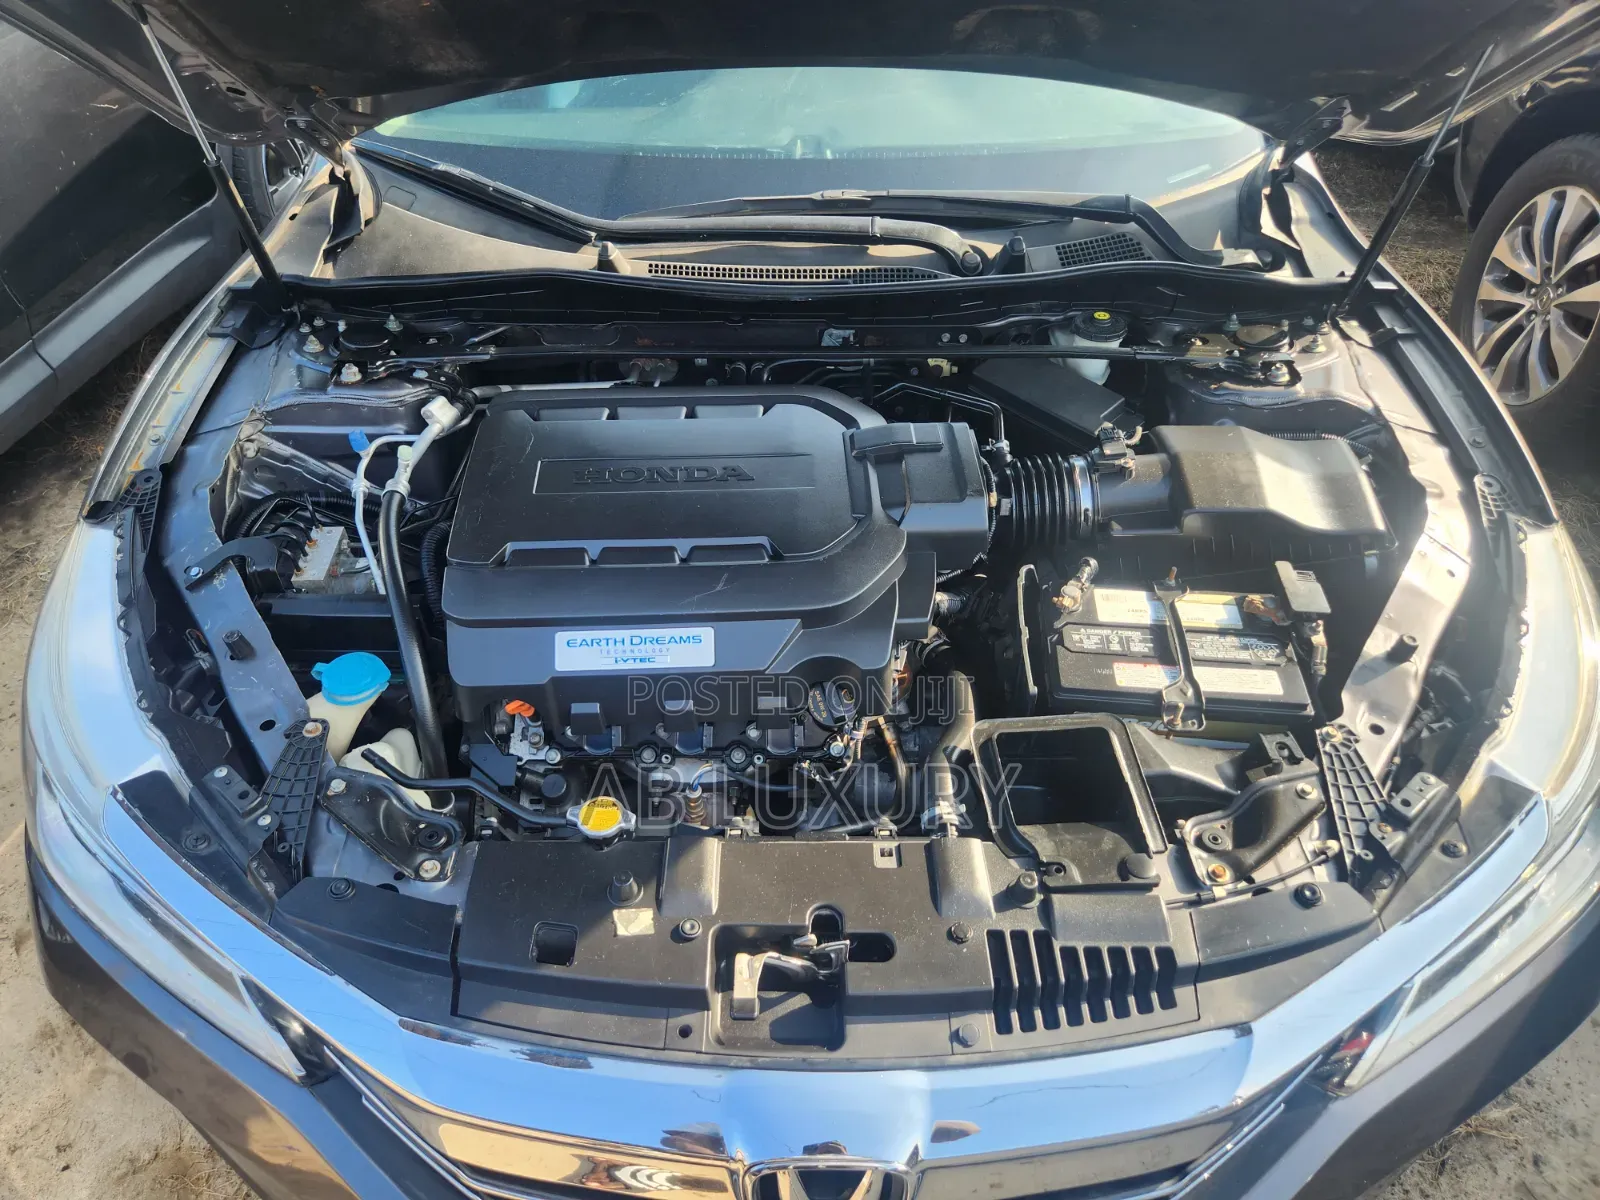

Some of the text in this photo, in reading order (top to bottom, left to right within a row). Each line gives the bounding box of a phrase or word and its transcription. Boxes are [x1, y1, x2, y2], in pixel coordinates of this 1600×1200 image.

[572, 464, 755, 484] HONDA
[566, 634, 702, 648] EARTH DREAMS
